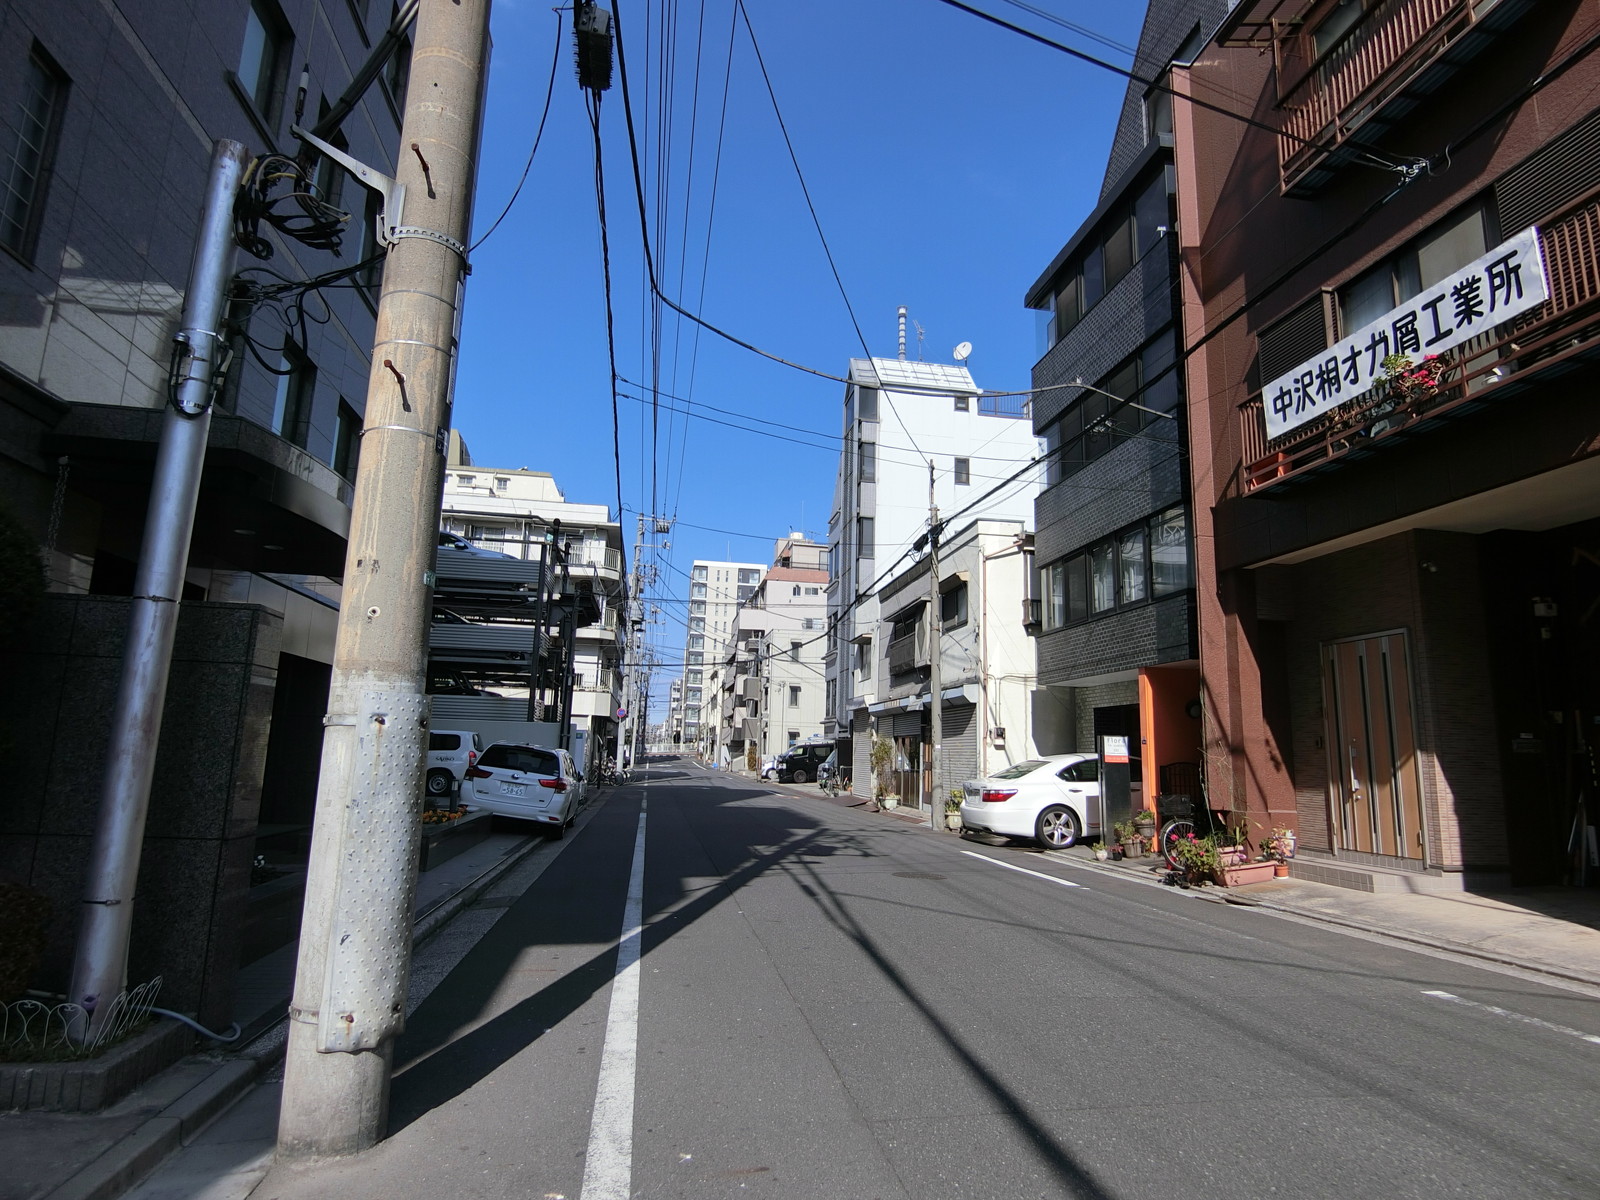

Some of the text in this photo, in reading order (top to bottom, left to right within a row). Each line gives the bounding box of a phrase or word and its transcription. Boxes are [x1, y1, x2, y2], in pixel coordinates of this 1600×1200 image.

[1272, 250, 1524, 423] 中沢桐オガ屑工業所
